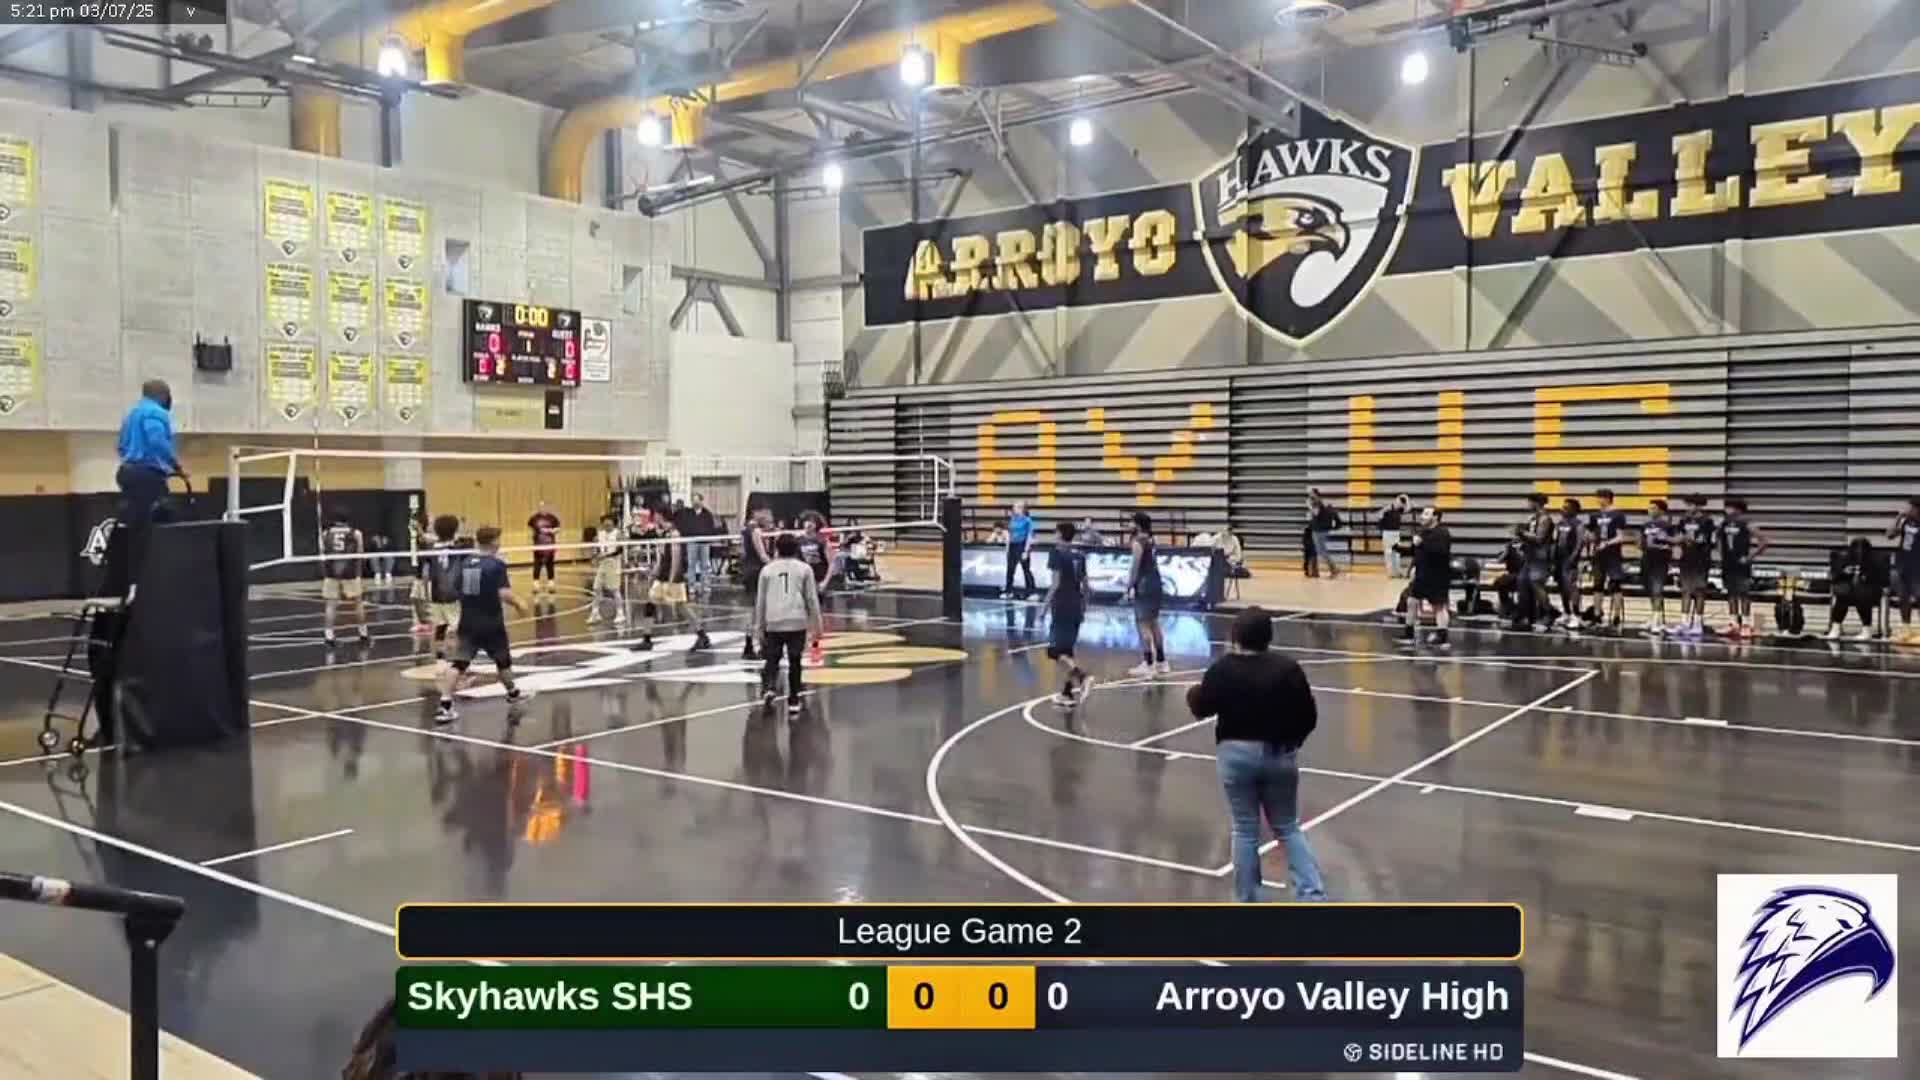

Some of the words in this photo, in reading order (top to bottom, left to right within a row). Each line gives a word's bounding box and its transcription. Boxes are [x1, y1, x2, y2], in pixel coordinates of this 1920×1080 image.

[1217, 138, 1393, 207] HAWKS
[1442, 103, 1920, 239] VALLEY
[904, 209, 1177, 301] ARROYO
[514, 305, 549, 327] 0:00
[488, 333, 501, 353] 0
[564, 341, 576, 358] 0
[333, 533, 345, 551] 5
